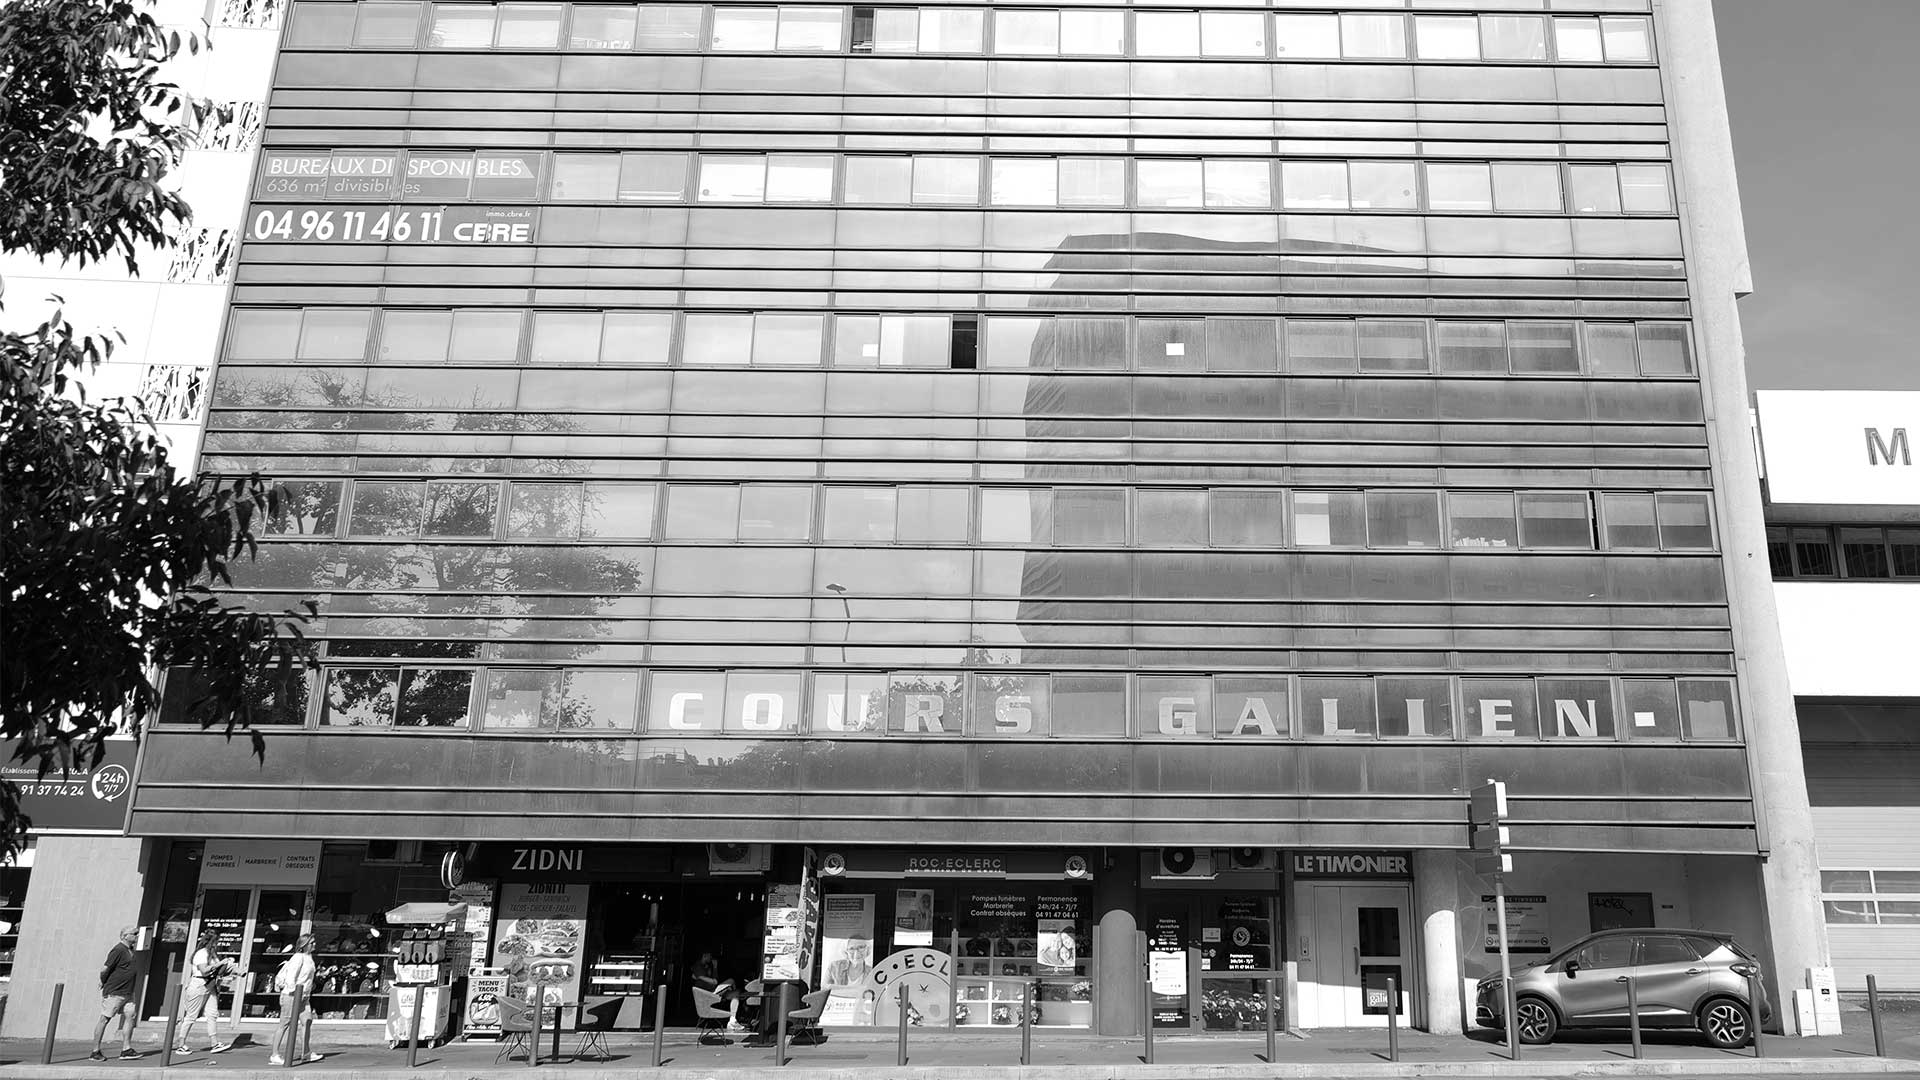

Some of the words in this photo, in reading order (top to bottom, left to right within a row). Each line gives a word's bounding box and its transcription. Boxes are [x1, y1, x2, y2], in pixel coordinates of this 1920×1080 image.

[270, 158, 366, 174] BUREAUX
[371, 158, 522, 176] DISPONIBLES
[266, 178, 298, 192] 636
[254, 209, 293, 240] 04
[300, 210, 335, 240] 96
[343, 211, 366, 240] 11
[370, 211, 412, 241] 46
[420, 212, 441, 241] 11
[453, 222, 530, 242] CBRE
[1864, 427, 1912, 466] M
[668, 692, 1032, 733] COURS
[1158, 696, 1597, 737] GALIEN
[101, 772, 125, 784] 24h
[20, 784, 34, 795] 91
[37, 785, 52, 796] 37
[54, 785, 68, 796] 74
[70, 786, 85, 796] 24
[103, 784, 119, 793] 7/7
[512, 849, 583, 871] ZIDNI
[1294, 855, 1313, 873] LE
[1318, 854, 1408, 873] TIMONIER
[970, 909, 995, 917] Contrat
[1035, 911, 1044, 919] 04
